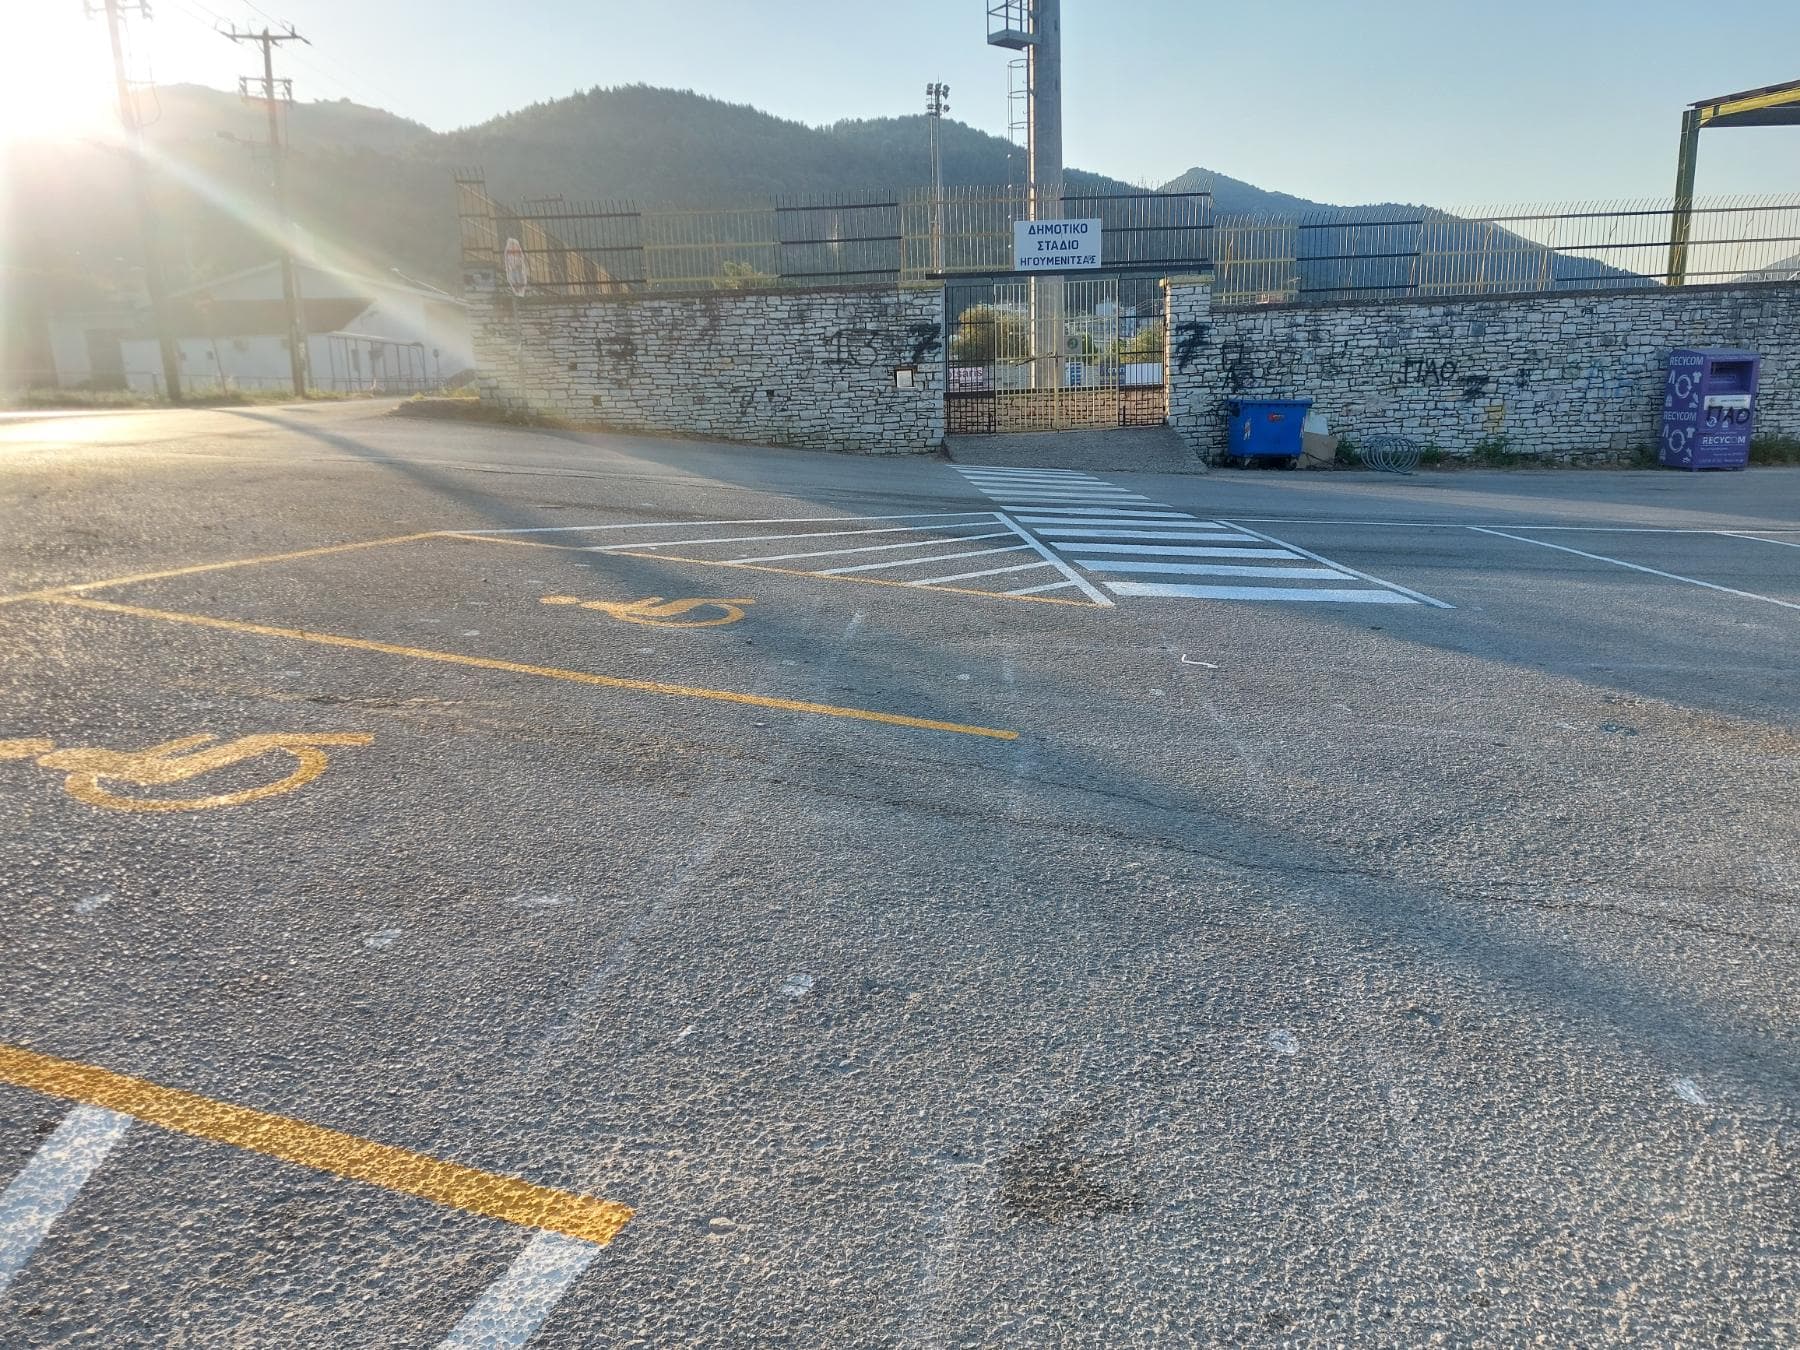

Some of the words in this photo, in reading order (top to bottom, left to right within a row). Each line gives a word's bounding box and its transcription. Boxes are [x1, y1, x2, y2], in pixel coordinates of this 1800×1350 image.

[1028, 223, 1088, 235] ΔΗΜΟΤΙΚΟ
[1037, 240, 1079, 251] ΣΤΑΔΙΟ
[1020, 255, 1097, 266] ΗΓΟΥΜΕΝΙΤΣΑΣ
[1669, 356, 1704, 366] RECYCOM
[1663, 410, 1697, 421] RECYCOM
